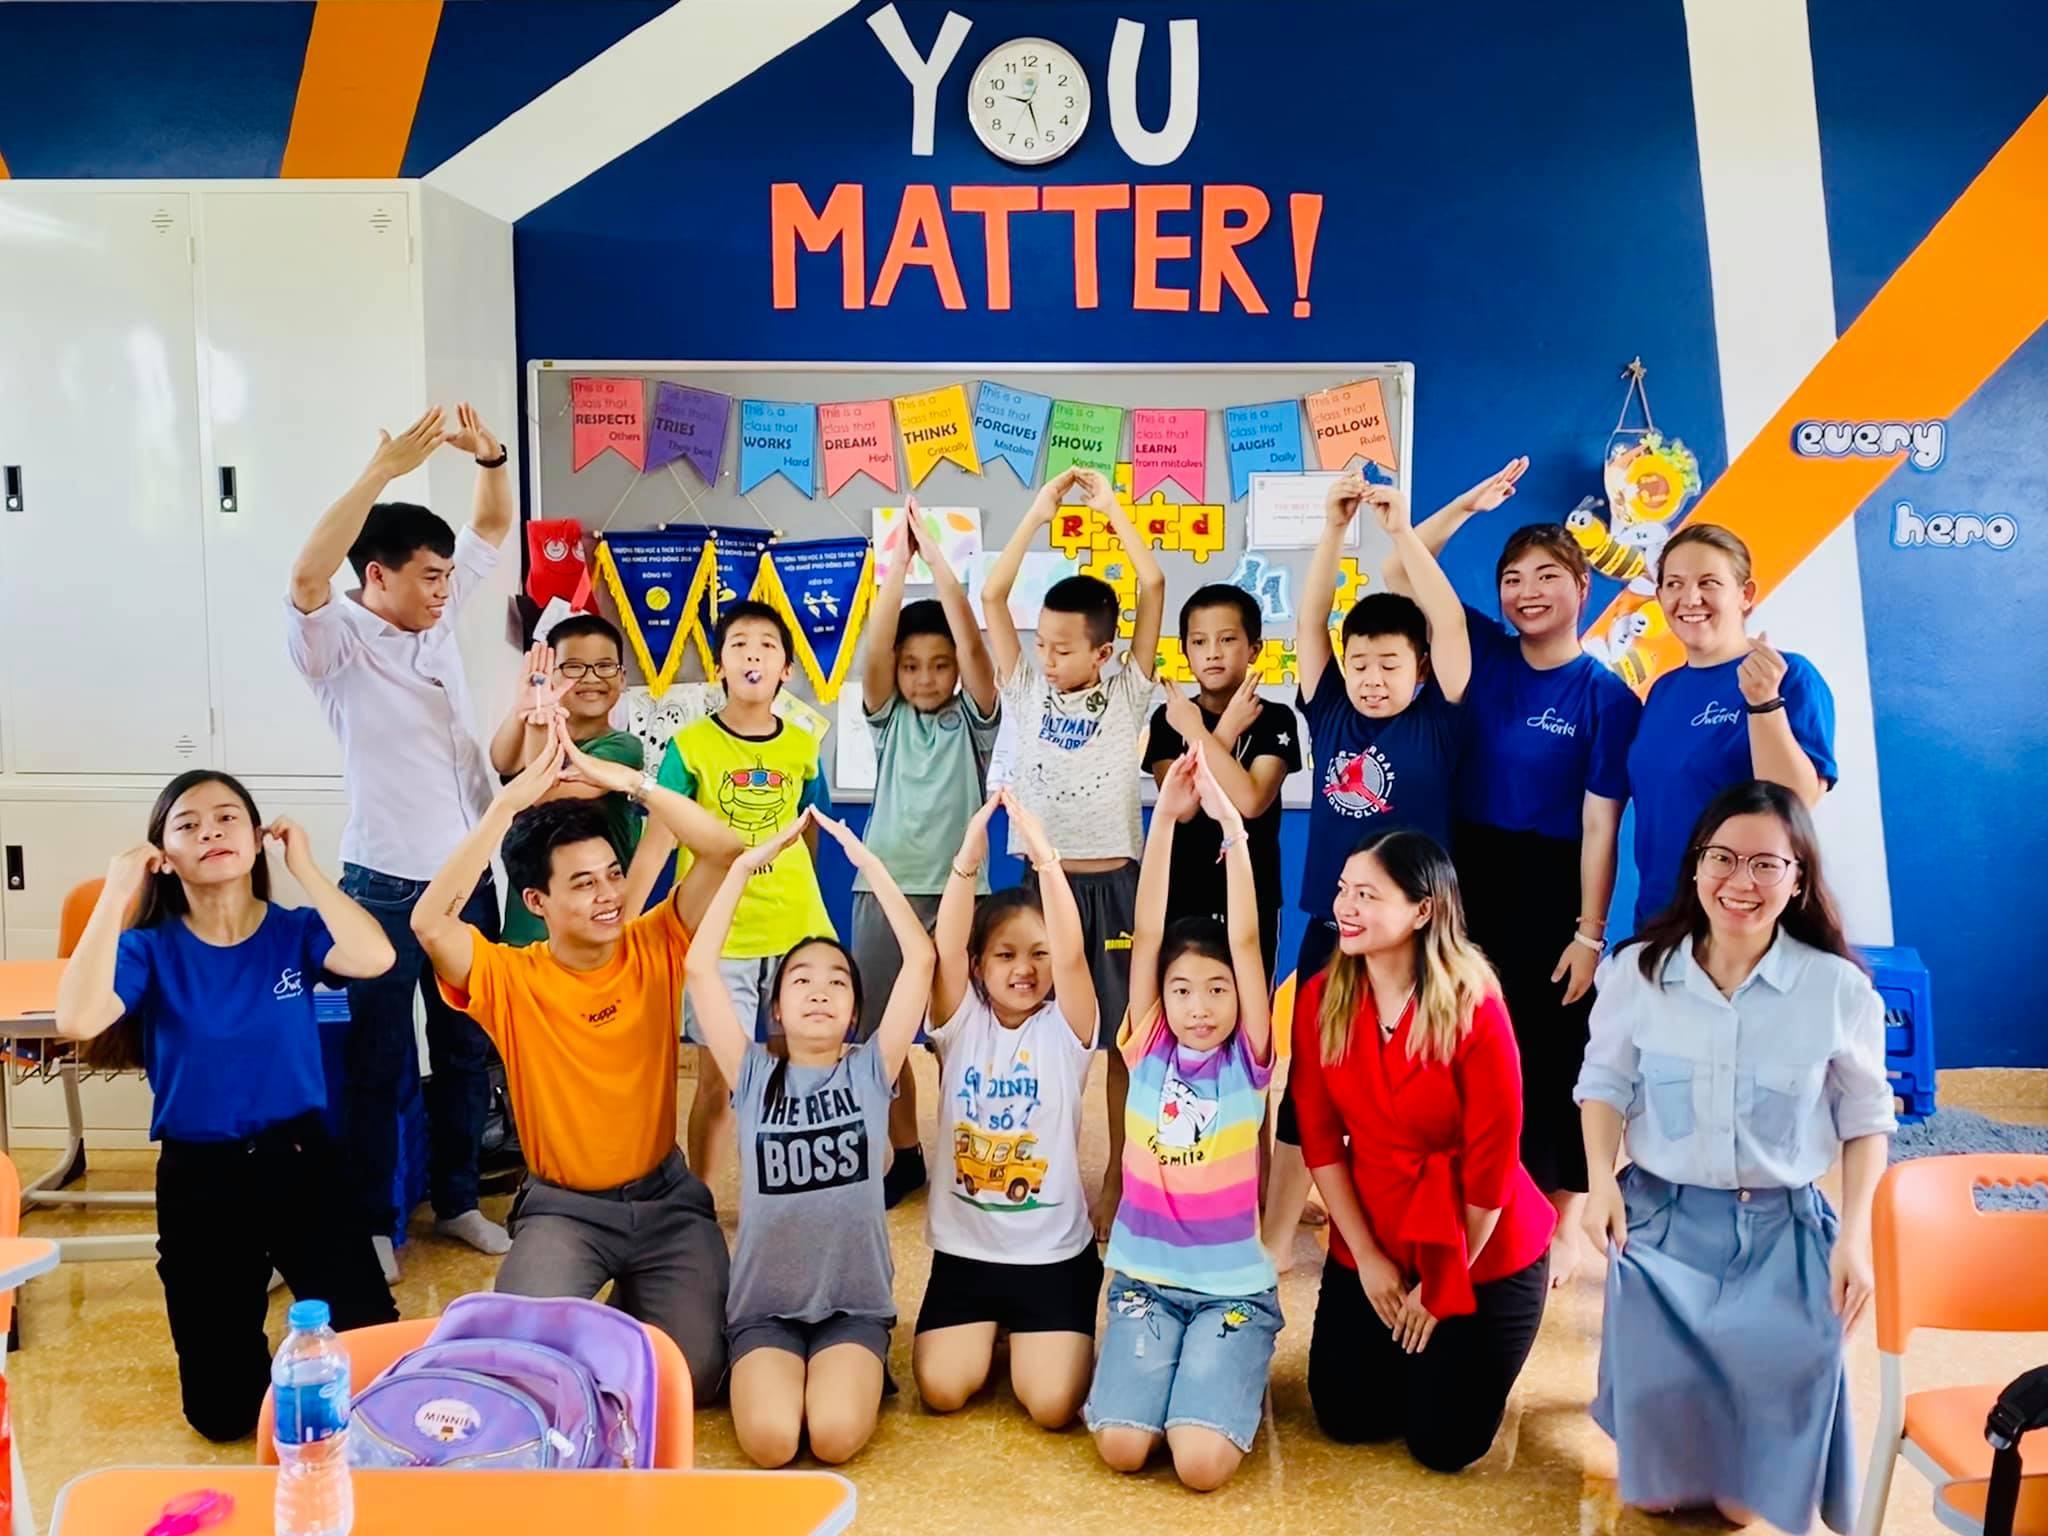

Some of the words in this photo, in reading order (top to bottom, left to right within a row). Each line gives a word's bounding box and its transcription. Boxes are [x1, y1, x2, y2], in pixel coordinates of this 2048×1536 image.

[1021, 55, 1038, 67] 12
[1004, 63, 1017, 74] 11
[990, 79, 1005, 91] 10
[1058, 75, 1068, 87] 2
[984, 96, 995, 109] 9
[1064, 96, 1074, 109] 3
[991, 118, 1002, 131] 8
[1060, 115, 1068, 126] 4
[1007, 133, 1016, 145] 7
[1045, 130, 1055, 142] 5
[1024, 137, 1034, 149] 6
[770, 182, 1323, 318] MATTER!
[928, 396, 937, 405] a
[1013, 395, 1022, 404] a
[1342, 391, 1351, 400] a
[777, 408, 786, 416] a
[853, 408, 862, 416] a
[901, 413, 928, 426] class
[929, 408, 951, 419] that
[978, 402, 1005, 416] class
[1007, 408, 1031, 422] that
[1086, 410, 1094, 418] a
[1259, 409, 1269, 419] a
[1313, 411, 1341, 424] class
[1343, 402, 1367, 417] that
[575, 414, 636, 425] RESPECTS
[1137, 414, 1156, 424] This
[1168, 415, 1177, 424] a
[656, 416, 696, 436] TRIES
[743, 421, 771, 432] class
[774, 422, 798, 433] that
[823, 423, 850, 433] class
[852, 421, 875, 432] that
[975, 416, 1038, 441] FORGIVES
[1054, 421, 1079, 432] class
[1082, 423, 1105, 434] that
[1230, 427, 1257, 438] class
[1260, 423, 1283, 434] that
[1317, 415, 1380, 439] FOLLOWS
[608, 431, 641, 441] Others
[903, 422, 958, 445] THINKS
[1136, 430, 1163, 440] class
[1166, 429, 1189, 440] that
[743, 437, 792, 449] WORKS
[825, 436, 878, 450] DREAMS
[1051, 435, 1103, 453] SHOWS
[1231, 438, 1276, 452] LAUGHS
[1360, 434, 1386, 447] Rules
[1797, 420, 1944, 469] every
[927, 443, 969, 457] Critically
[1135, 444, 1177, 454] LEARNS
[783, 457, 810, 467] Hard
[868, 454, 892, 464] High
[1135, 458, 1159, 468] from
[1160, 458, 1203, 468] mistakes
[1270, 452, 1296, 464] Daily
[1894, 501, 2017, 548] hero
[805, 1087, 862, 1125] REAL
[763, 1130, 860, 1188] BOSS
